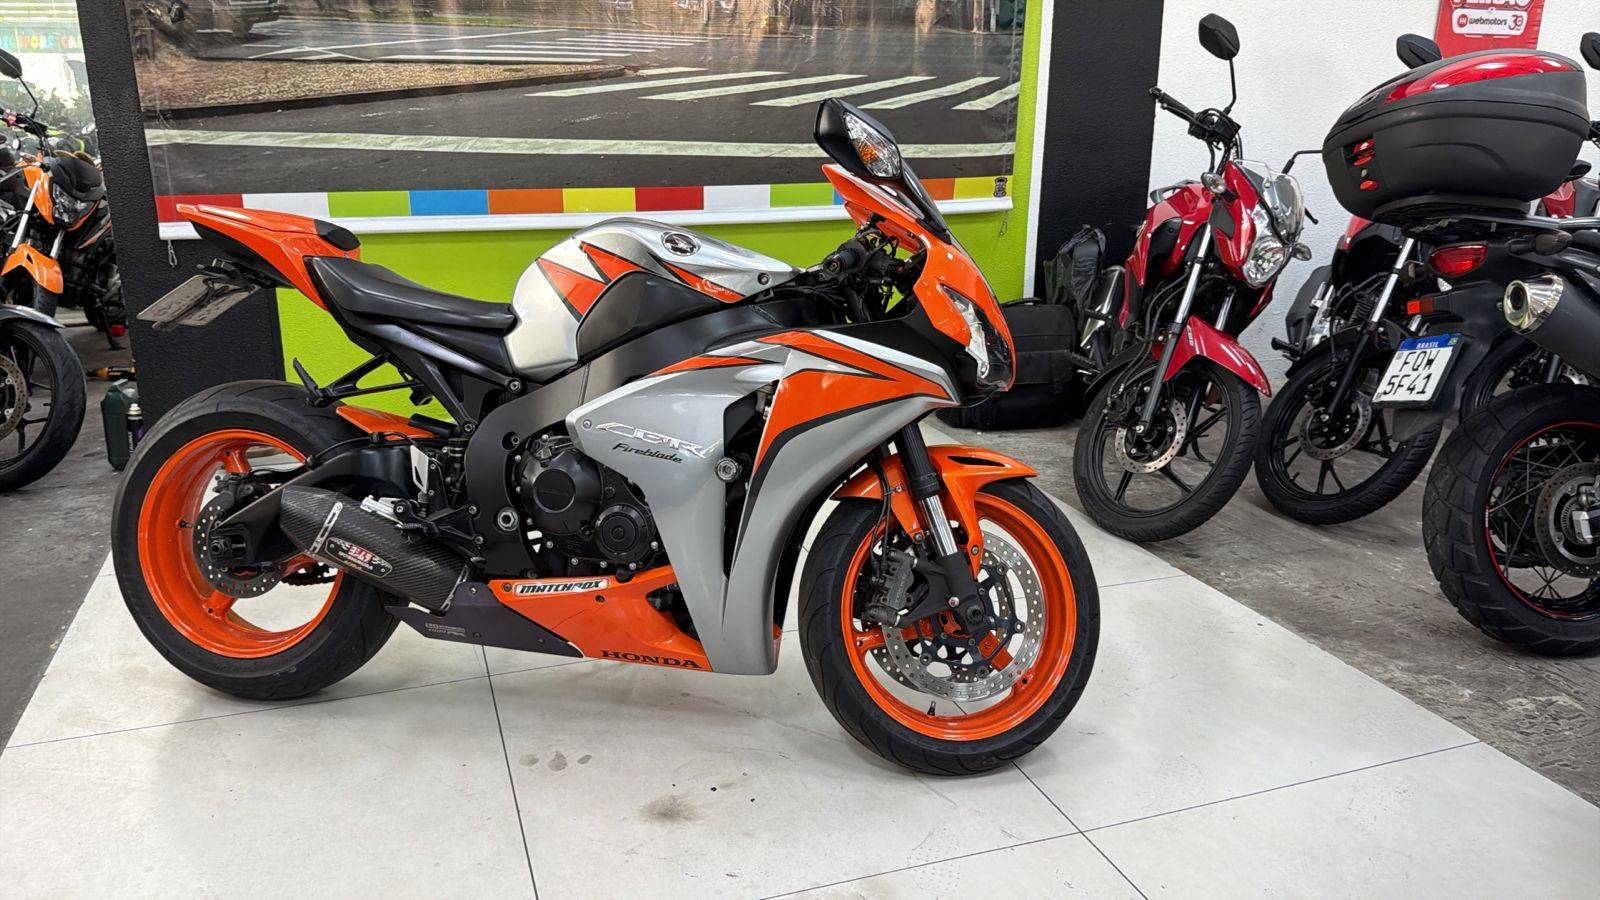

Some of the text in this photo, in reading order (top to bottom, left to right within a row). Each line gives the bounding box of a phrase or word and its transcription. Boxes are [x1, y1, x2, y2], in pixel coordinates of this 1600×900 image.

[1468, 16, 1507, 26] webmotors
[1416, 342, 1439, 350] BRASIL
[1399, 350, 1440, 372] FQW
[1383, 373, 1432, 395] 5F41
[613, 443, 683, 464] Fireblade
[601, 650, 701, 669] HONDA
